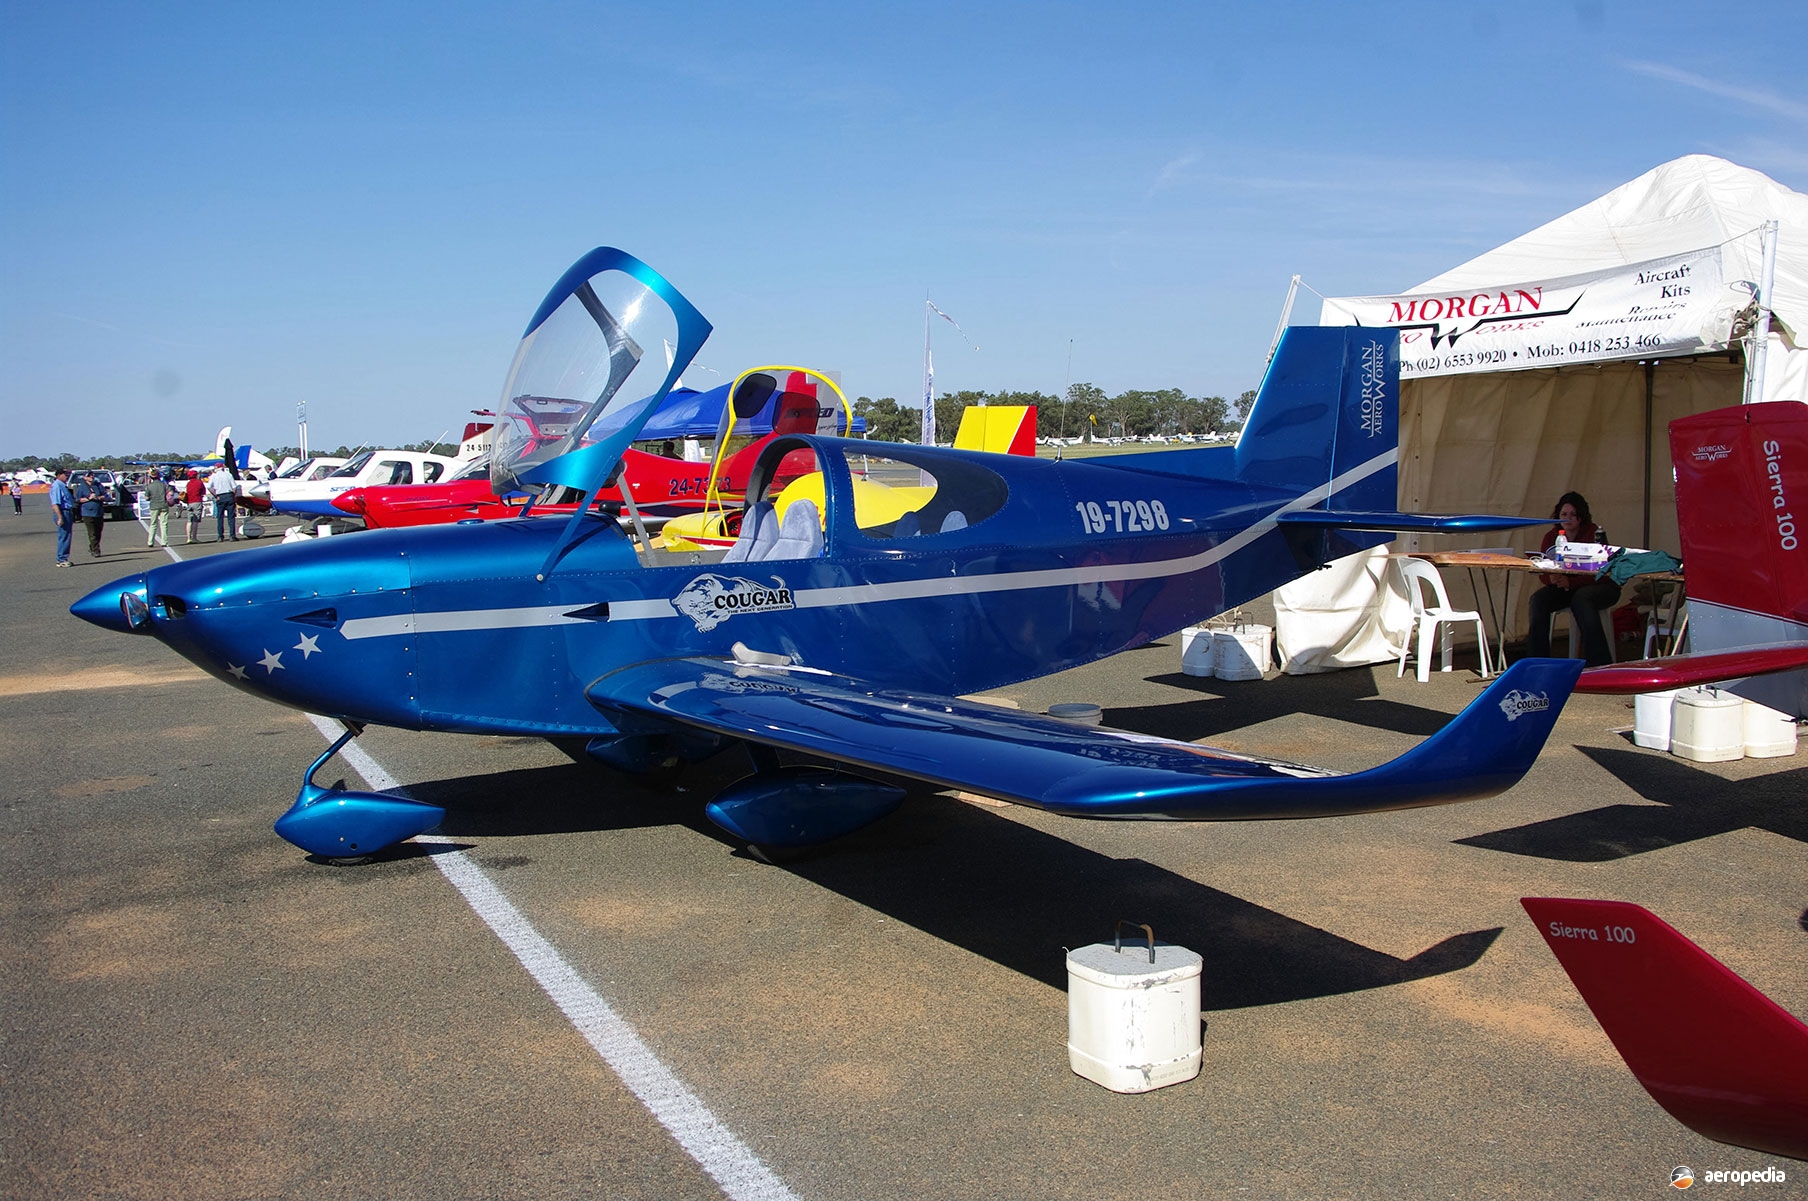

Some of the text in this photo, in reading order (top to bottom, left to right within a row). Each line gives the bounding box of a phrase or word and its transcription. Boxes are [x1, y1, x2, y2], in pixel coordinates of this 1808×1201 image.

[1634, 264, 1692, 286] Aircraft
[1660, 285, 1691, 300] Kits
[1386, 286, 1543, 323] MORGAN
[1399, 333, 1662, 372] Ph (02) 6553 9920 Mob: 0418 253 466
[1360, 346, 1373, 430] MORGAN
[1697, 444, 1726, 453] MORGAN
[1763, 440, 1798, 551] Sierra 100
[1075, 500, 1170, 534] 19-7298
[714, 589, 791, 609] COUGAR
[1517, 698, 1549, 709] COUGAR
[1549, 921, 1636, 944] Sierra 100
